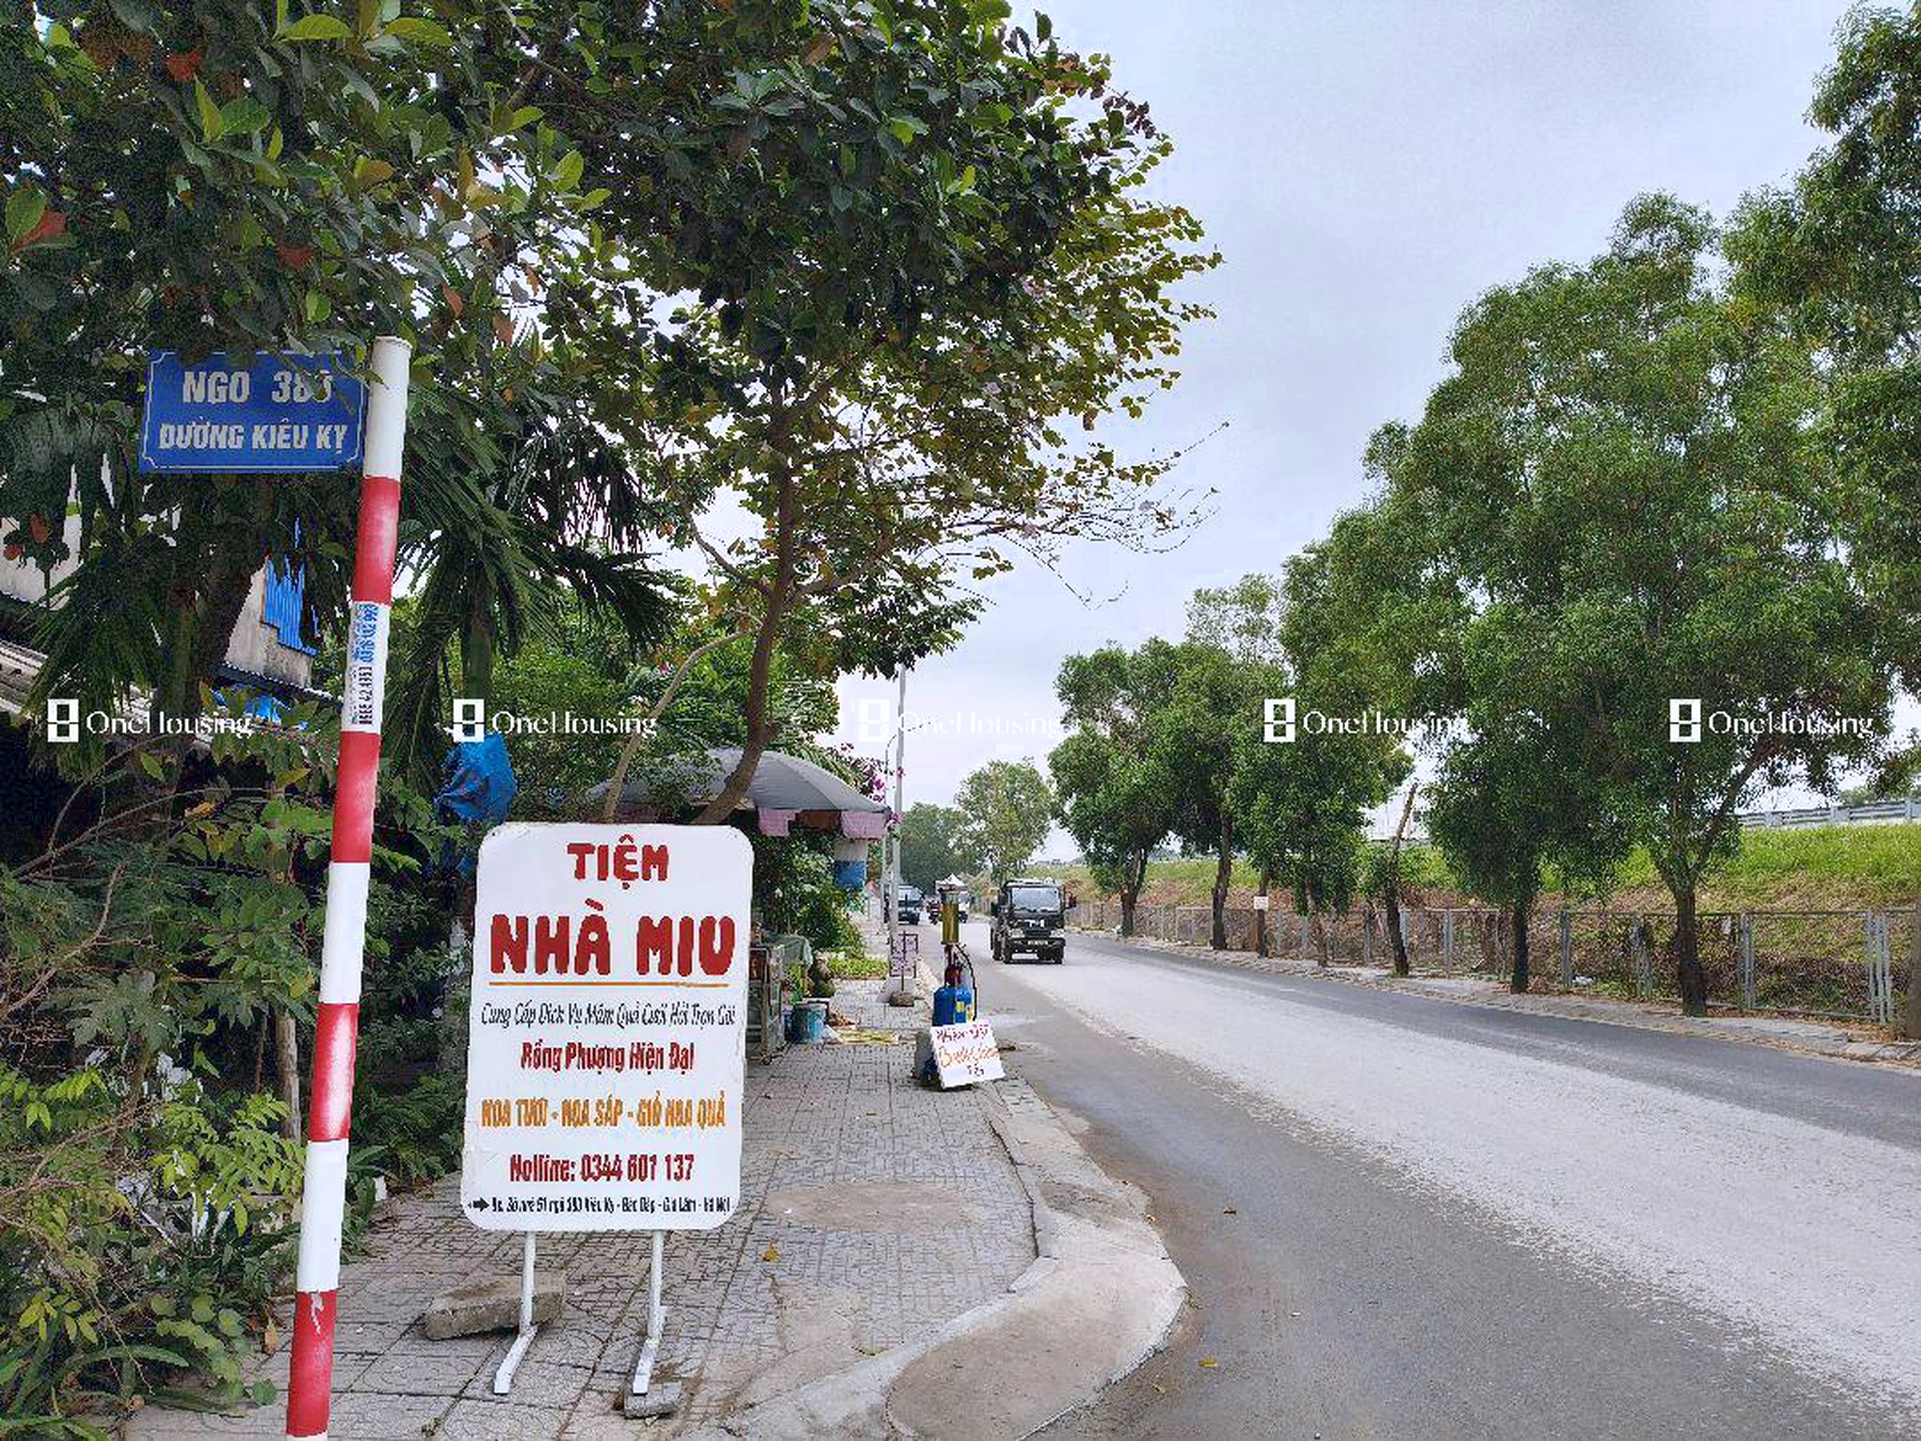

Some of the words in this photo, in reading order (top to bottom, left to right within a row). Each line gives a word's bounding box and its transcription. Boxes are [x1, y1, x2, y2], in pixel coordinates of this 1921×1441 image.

[159, 416, 244, 450] ĐƯỜNG
[567, 834, 669, 890] TIỆM
[490, 898, 611, 975] NHÀ
[636, 915, 736, 977] MIU
[481, 1003, 511, 1029] Cung
[564, 1042, 625, 1075] Phượng
[629, 1042, 664, 1075] Hiện
[668, 1042, 695, 1075] Đại
[481, 1099, 511, 1127] HOA
[561, 1099, 590, 1128] HOA
[594, 1094, 623, 1127] SÁP
[664, 1099, 693, 1128] HOA
[696, 1091, 726, 1129] QUẢ
[580, 1154, 624, 1182] 0344
[627, 1154, 658, 1182] 601
[664, 1154, 695, 1182] 137
